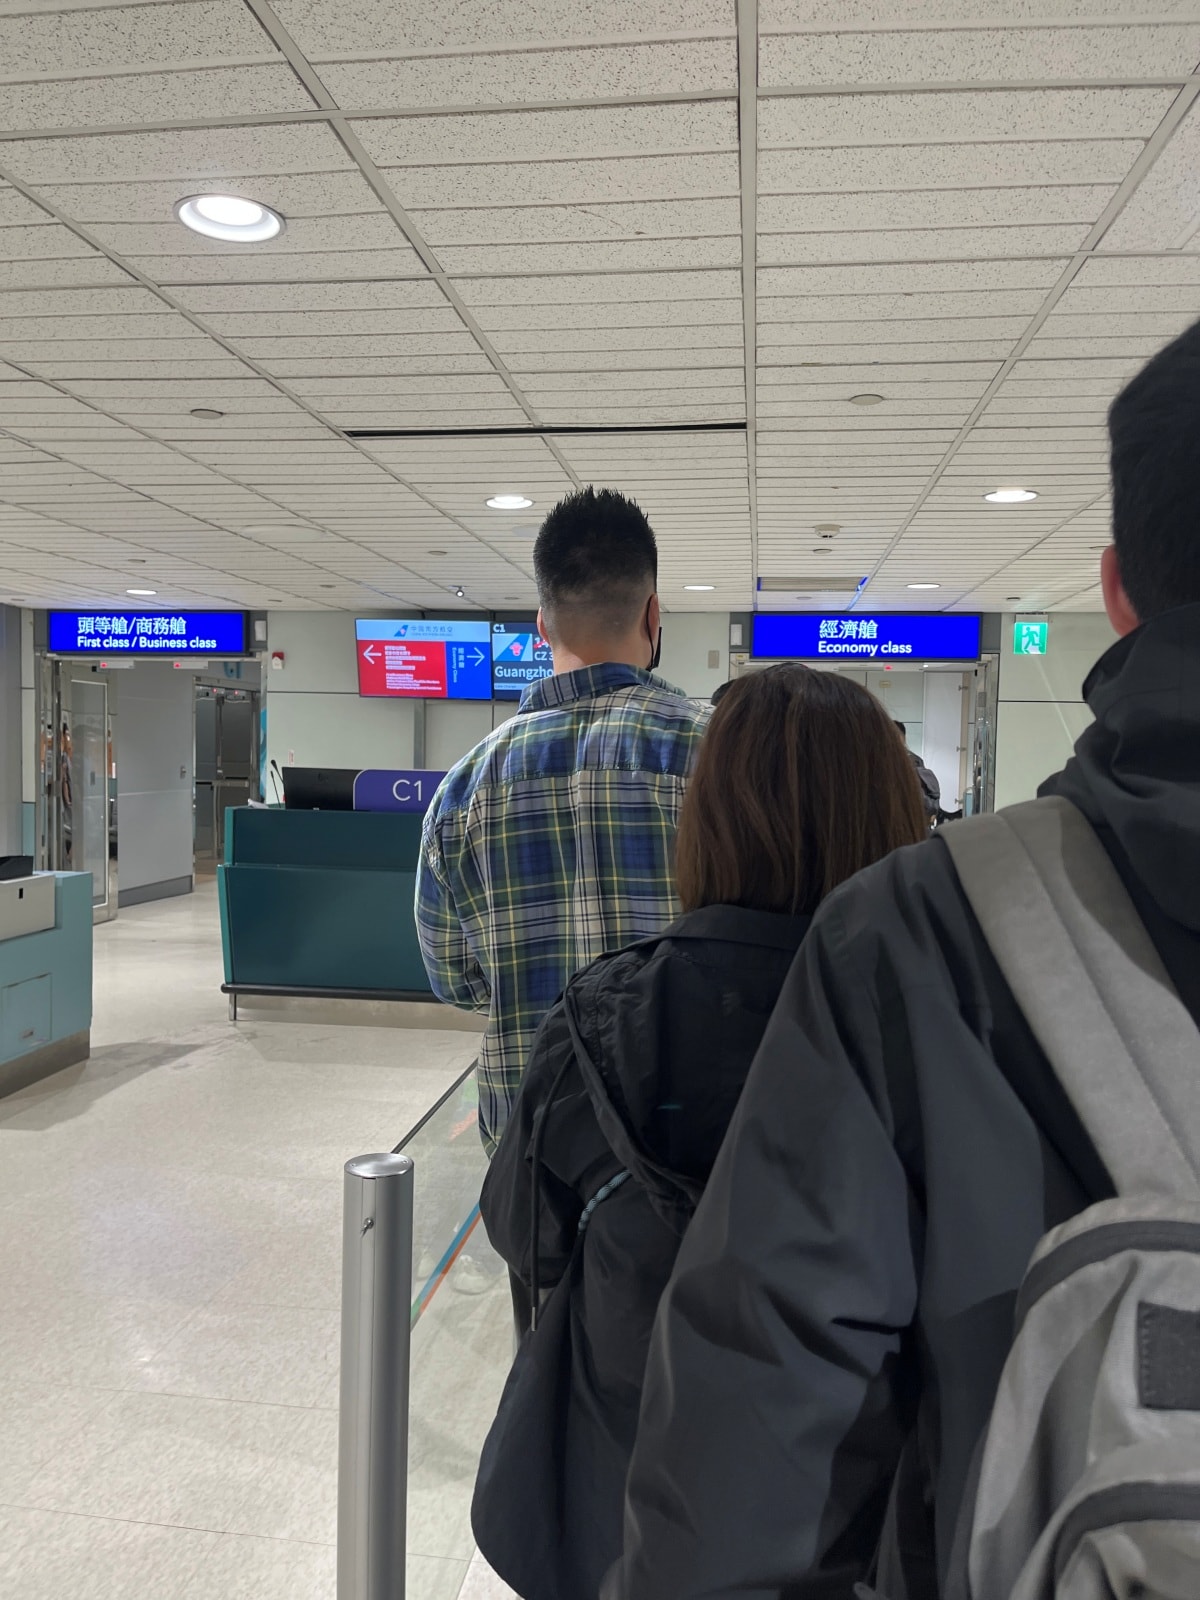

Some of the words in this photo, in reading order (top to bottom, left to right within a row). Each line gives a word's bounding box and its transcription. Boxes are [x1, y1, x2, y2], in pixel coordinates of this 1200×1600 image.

[77, 616, 187, 635] 頭等艙/商務艙
[493, 624, 506, 633] C1
[819, 619, 879, 639] 經濟艙
[77, 637, 101, 648] First
[103, 637, 130, 648] class
[139, 637, 187, 648] Business
[189, 637, 217, 648] class
[818, 641, 879, 656] Economy
[881, 641, 912, 654] class
[534, 651, 547, 661] CZ
[393, 779, 422, 801] C1
